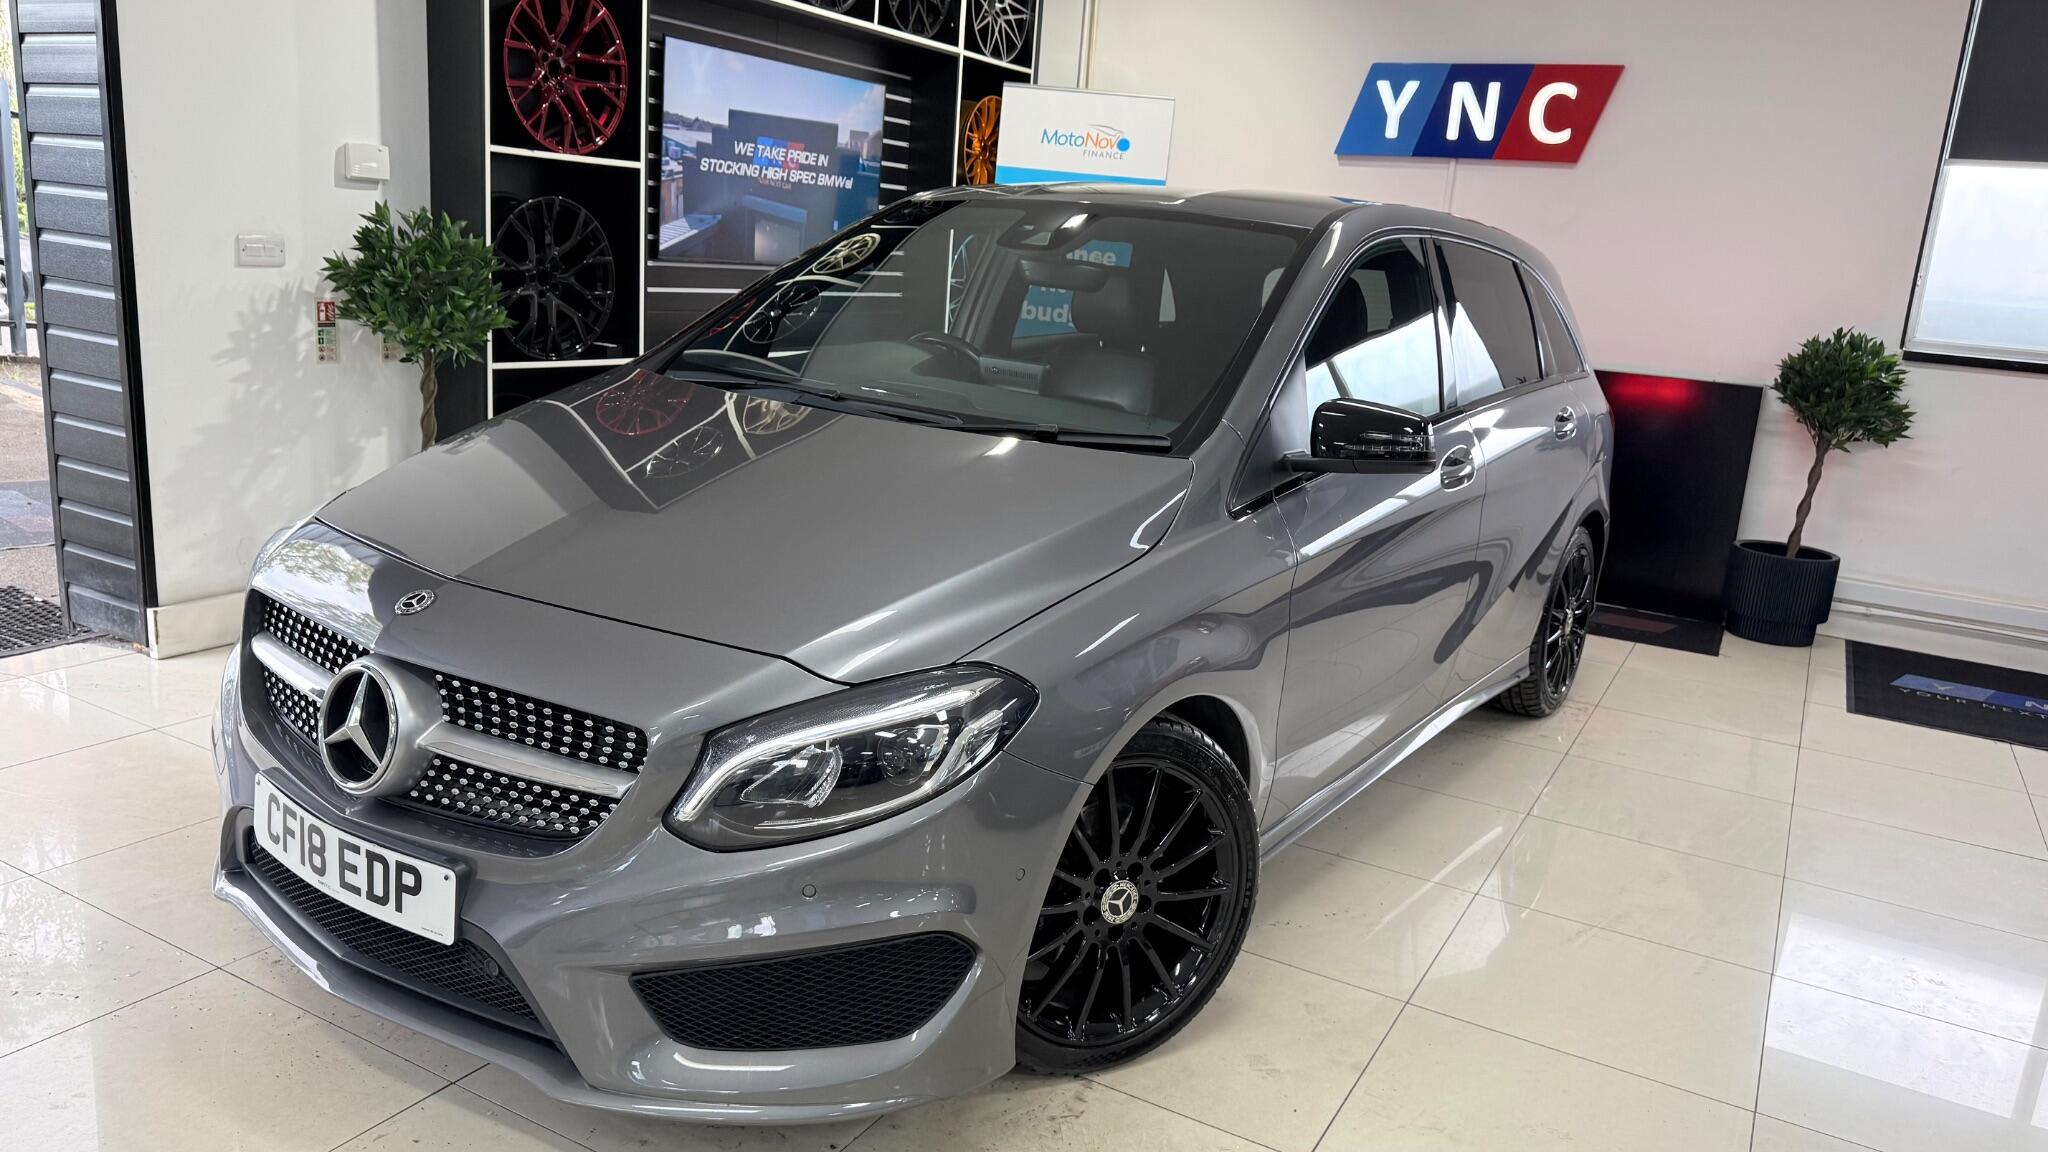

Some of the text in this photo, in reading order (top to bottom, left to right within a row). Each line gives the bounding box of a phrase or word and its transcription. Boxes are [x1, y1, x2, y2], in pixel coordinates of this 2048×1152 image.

[1376, 80, 1578, 145] YNC
[734, 141, 829, 167] WE TAKE PRIDE IN
[1083, 149, 1125, 160] FINANCE
[700, 157, 759, 177] STOCKING
[761, 166, 788, 181] HIGH
[789, 170, 816, 185] SPEC
[1900, 688, 1967, 704] YOUR
[267, 792, 422, 914] CF18 EDP
